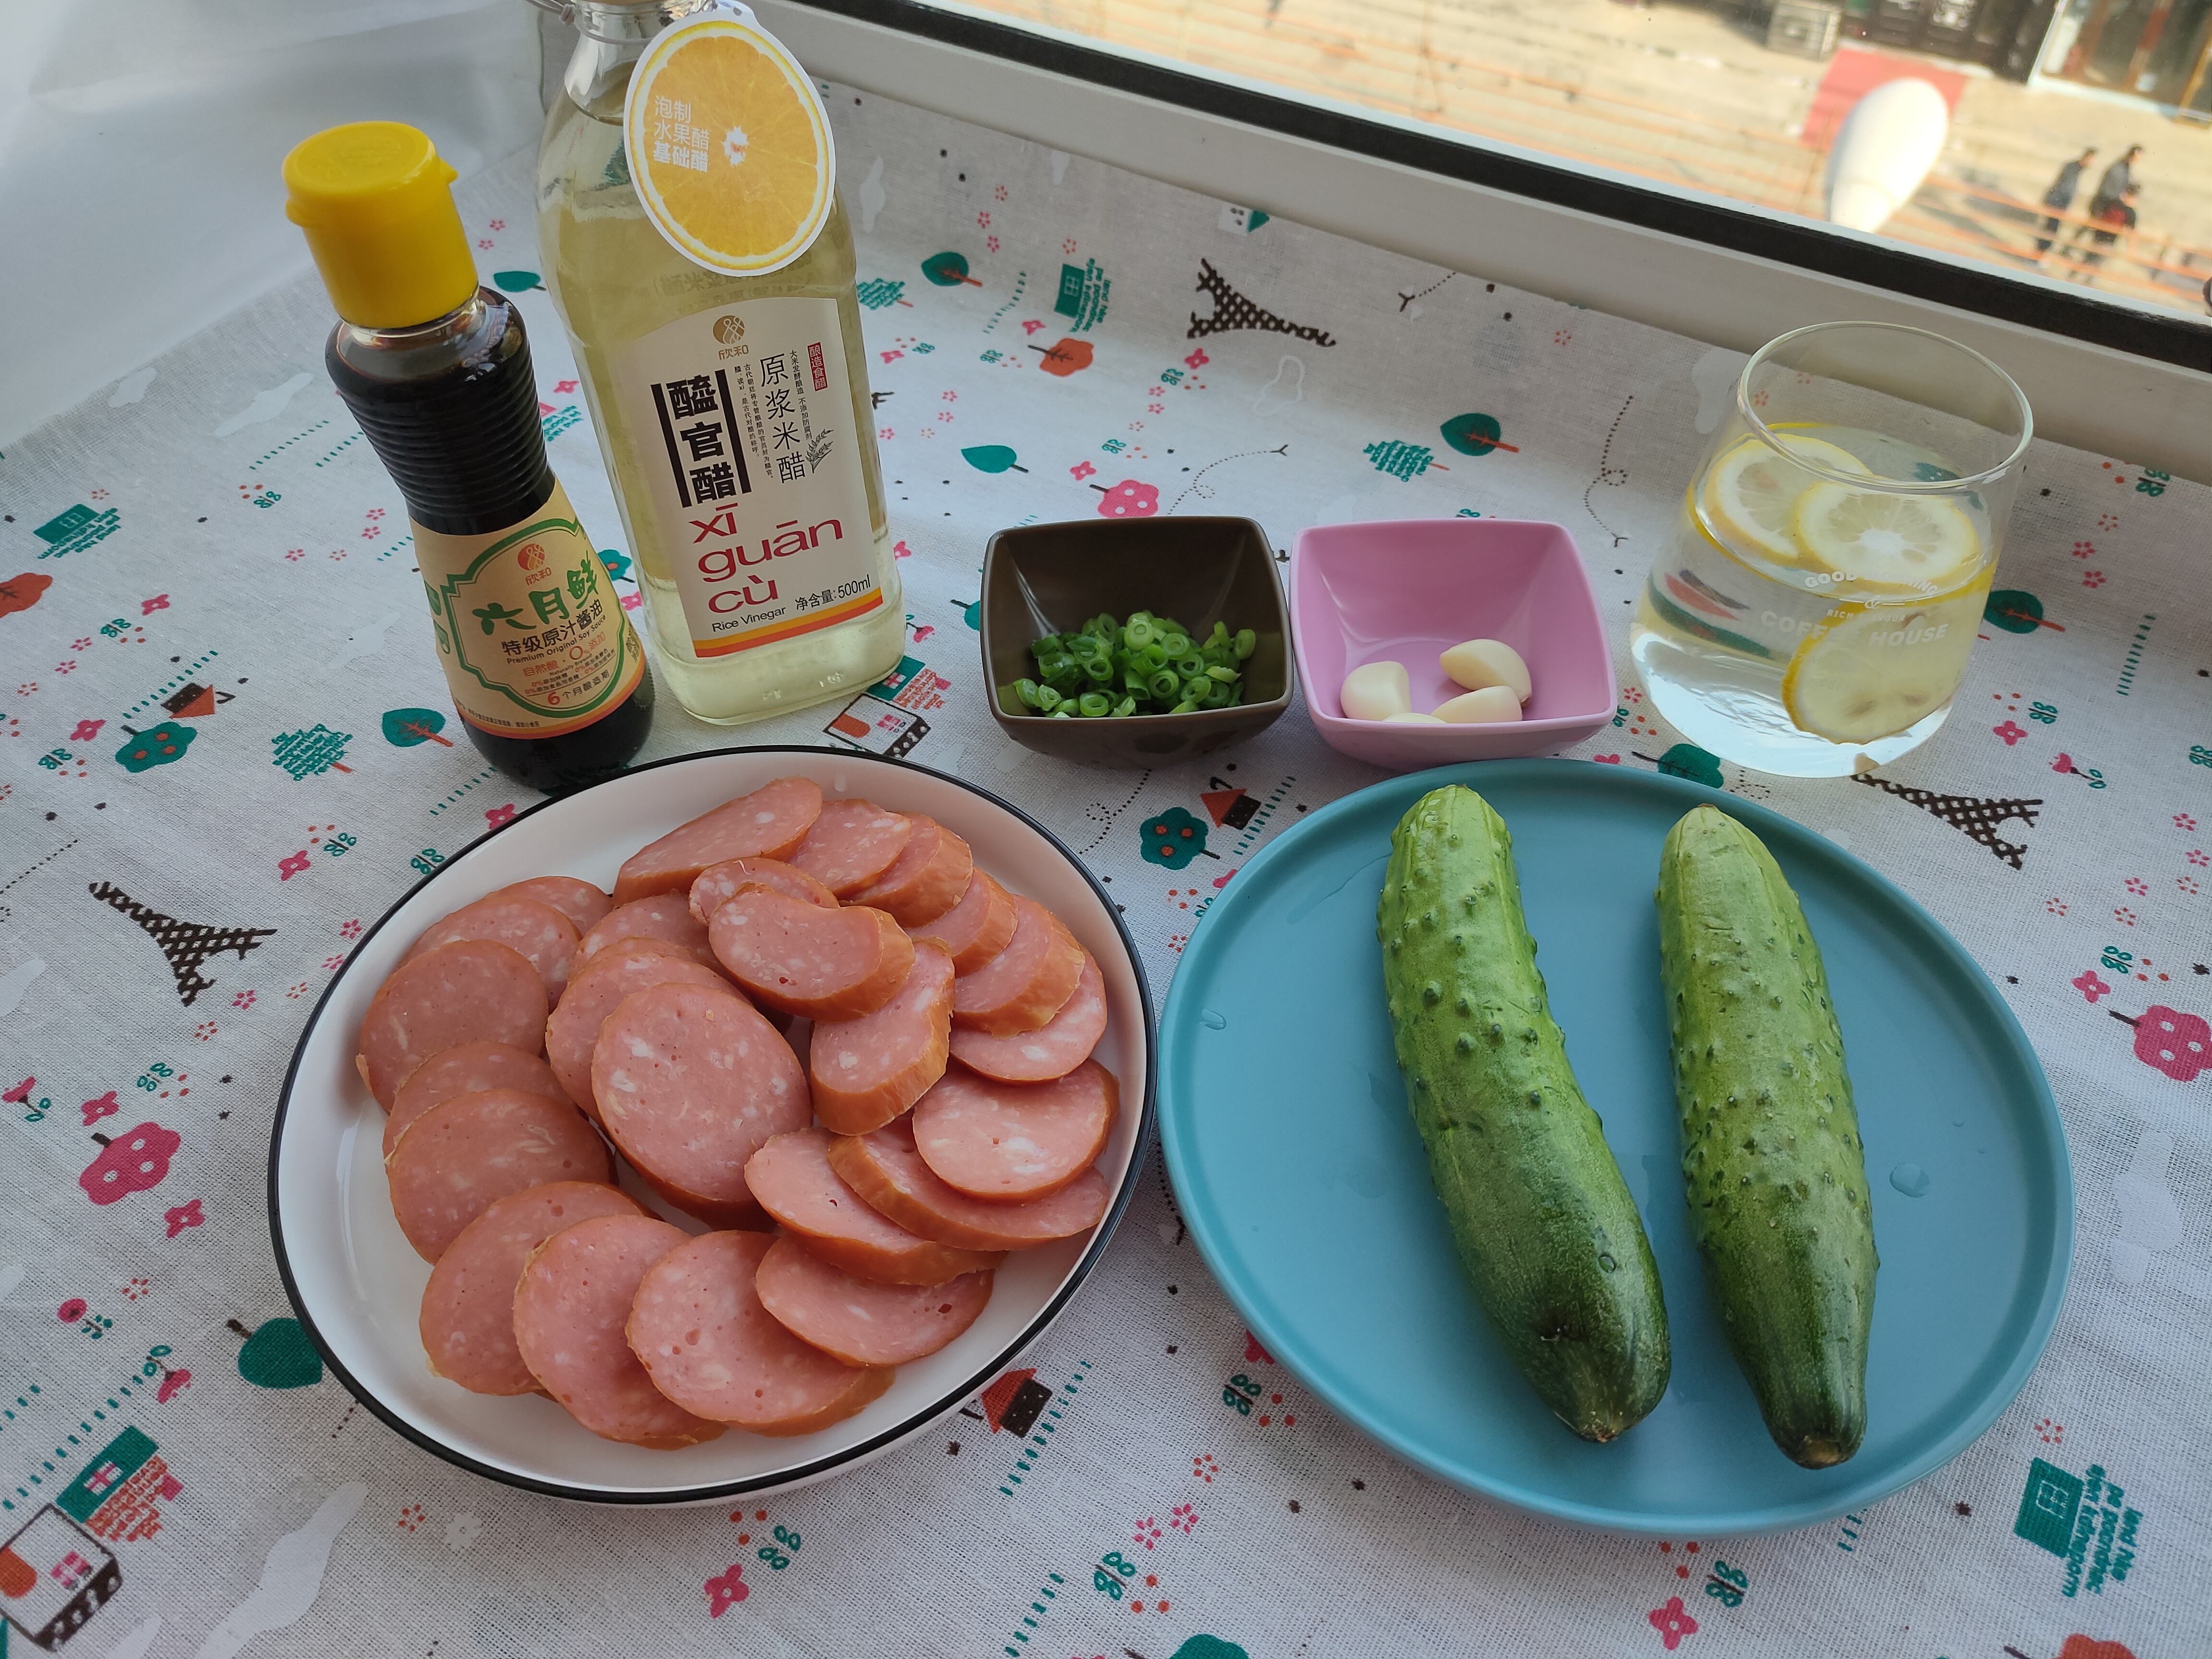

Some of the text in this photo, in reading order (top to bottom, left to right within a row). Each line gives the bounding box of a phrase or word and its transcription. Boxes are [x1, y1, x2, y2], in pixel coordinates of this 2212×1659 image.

[654, 95, 691, 123] 泡制
[654, 119, 709, 151] 水果醋
[653, 141, 708, 173] 基础醋
[719, 345, 749, 360] 欣和
[809, 345, 826, 390] 酿造食醋
[760, 354, 805, 483] 原浆米醋
[525, 567, 552, 586] 欣和
[1804, 571, 1857, 588] GOOD
[472, 550, 599, 635] 六月鲜
[502, 599, 603, 656] 特级原汁酱油
[712, 607, 786, 632] Rice Vinegar
[1827, 610, 1853, 619] RICH
[507, 615, 606, 664] Premium Original Soy Sauce
[1868, 623, 1949, 647] HOUSE
[550, 665, 574, 676] Naturally
